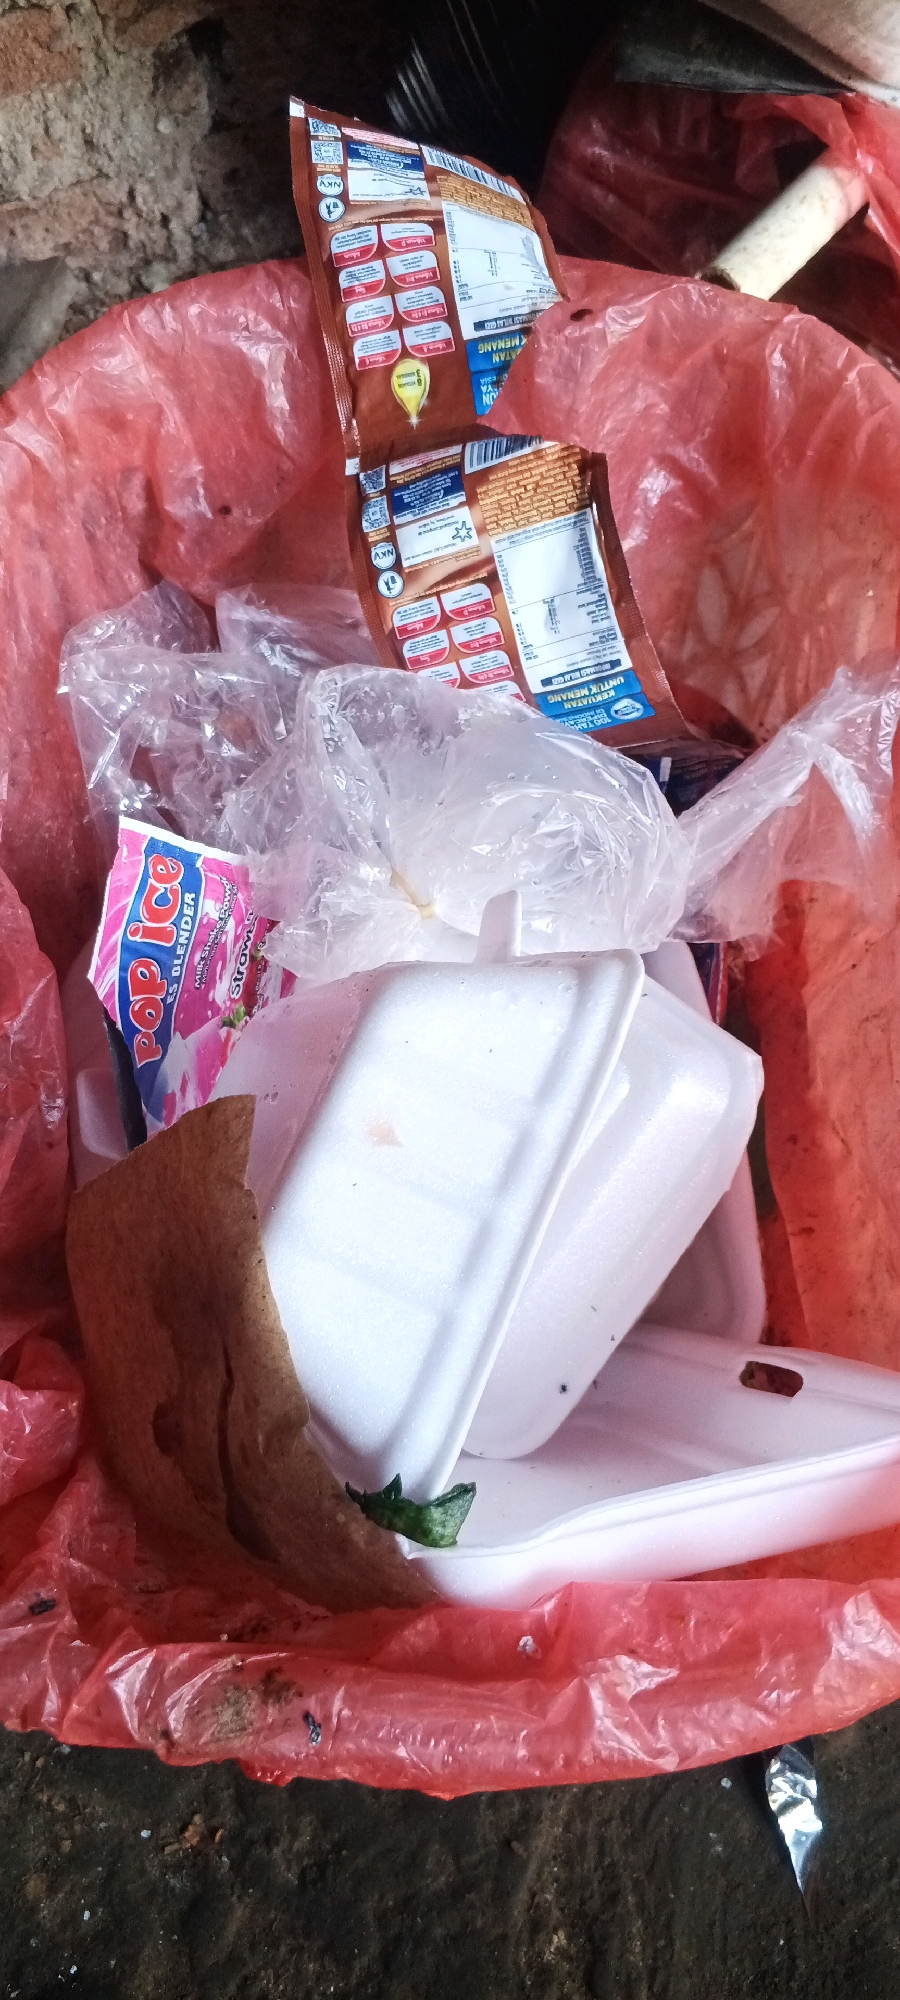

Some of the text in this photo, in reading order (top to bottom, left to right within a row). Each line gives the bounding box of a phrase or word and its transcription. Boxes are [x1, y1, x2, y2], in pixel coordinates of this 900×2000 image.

[319, 180, 342, 190] NKV
[477, 335, 520, 354] MENANG
[493, 348, 521, 363] ATAN
[373, 548, 394, 562] NKV
[547, 676, 625, 704] UNTUK MENANG
[563, 689, 616, 710] KEKUATAN
[594, 717, 612, 727] 100
[166, 892, 197, 1005] ES BLENDER
[195, 960, 206, 988] Milk
[201, 919, 225, 959] Shake
